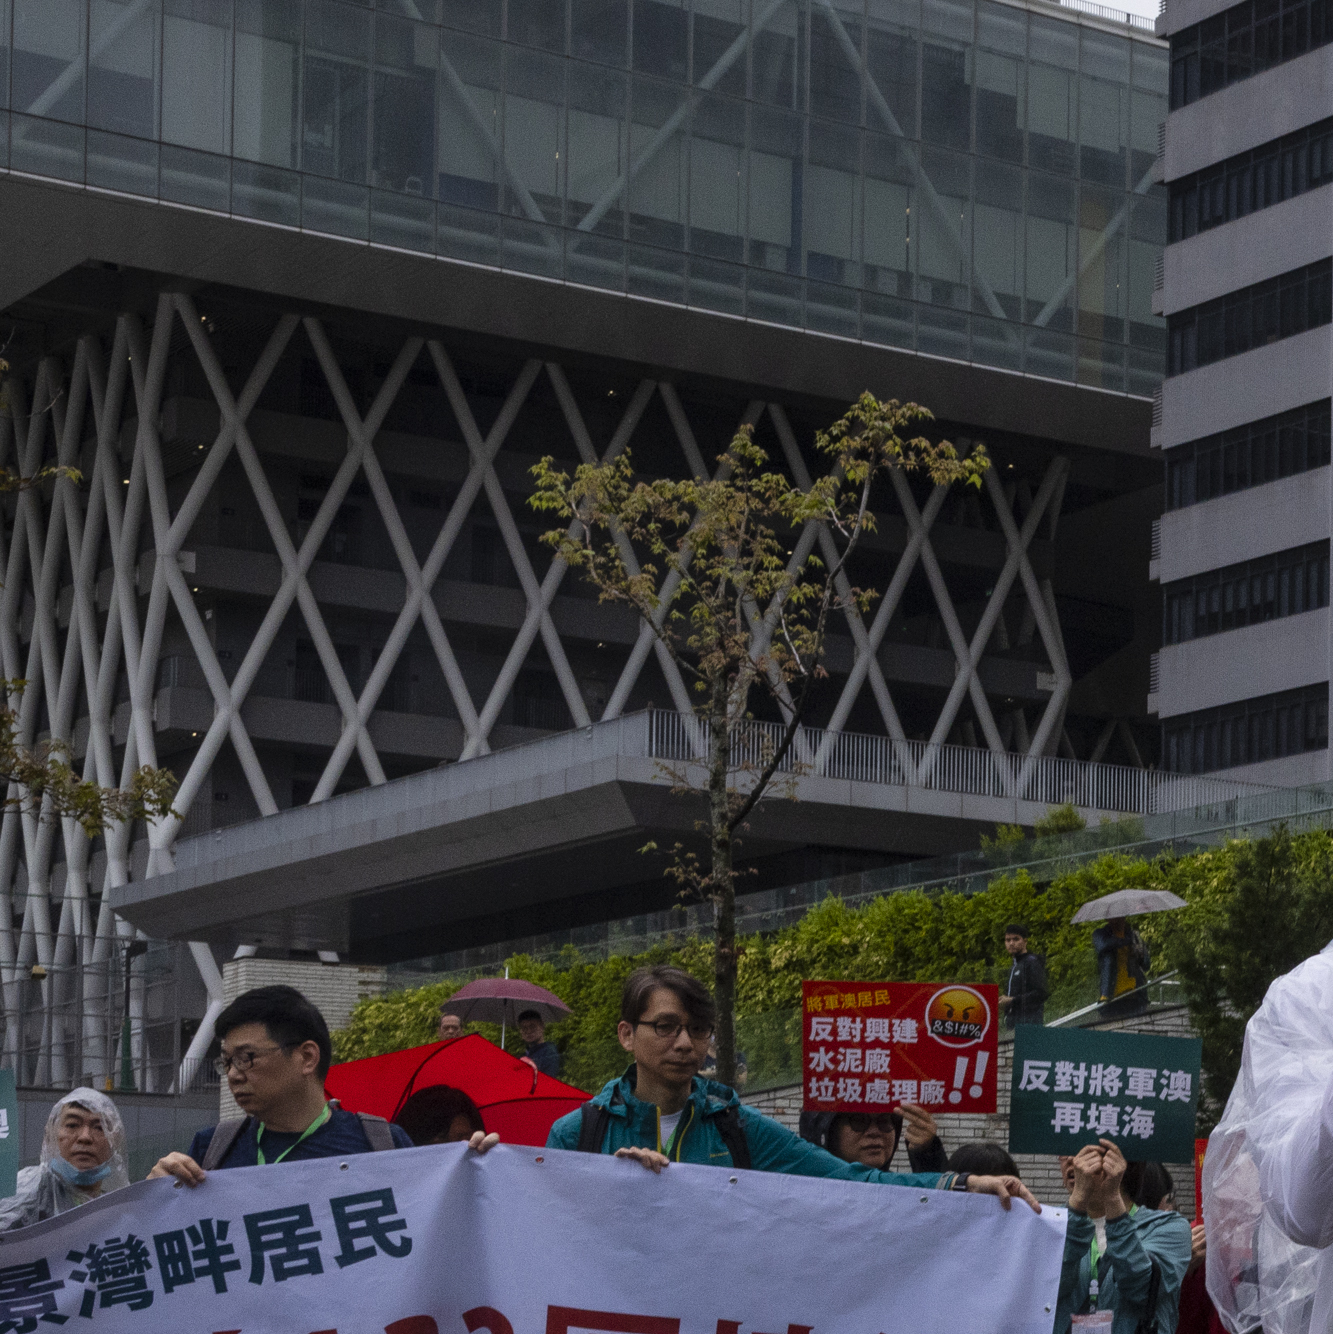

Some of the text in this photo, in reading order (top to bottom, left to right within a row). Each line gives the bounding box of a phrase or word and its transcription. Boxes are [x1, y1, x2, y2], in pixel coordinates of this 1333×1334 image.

[806, 989, 891, 1013] 將軍澳居民
[809, 1016, 919, 1044] 反對興建
[809, 1047, 891, 1074] 水泥廠
[809, 1077, 946, 1105] 垃圾處理廠
[1018, 1060, 1192, 1103] 反對將軍澳
[1050, 1101, 1155, 1139] 再填海
